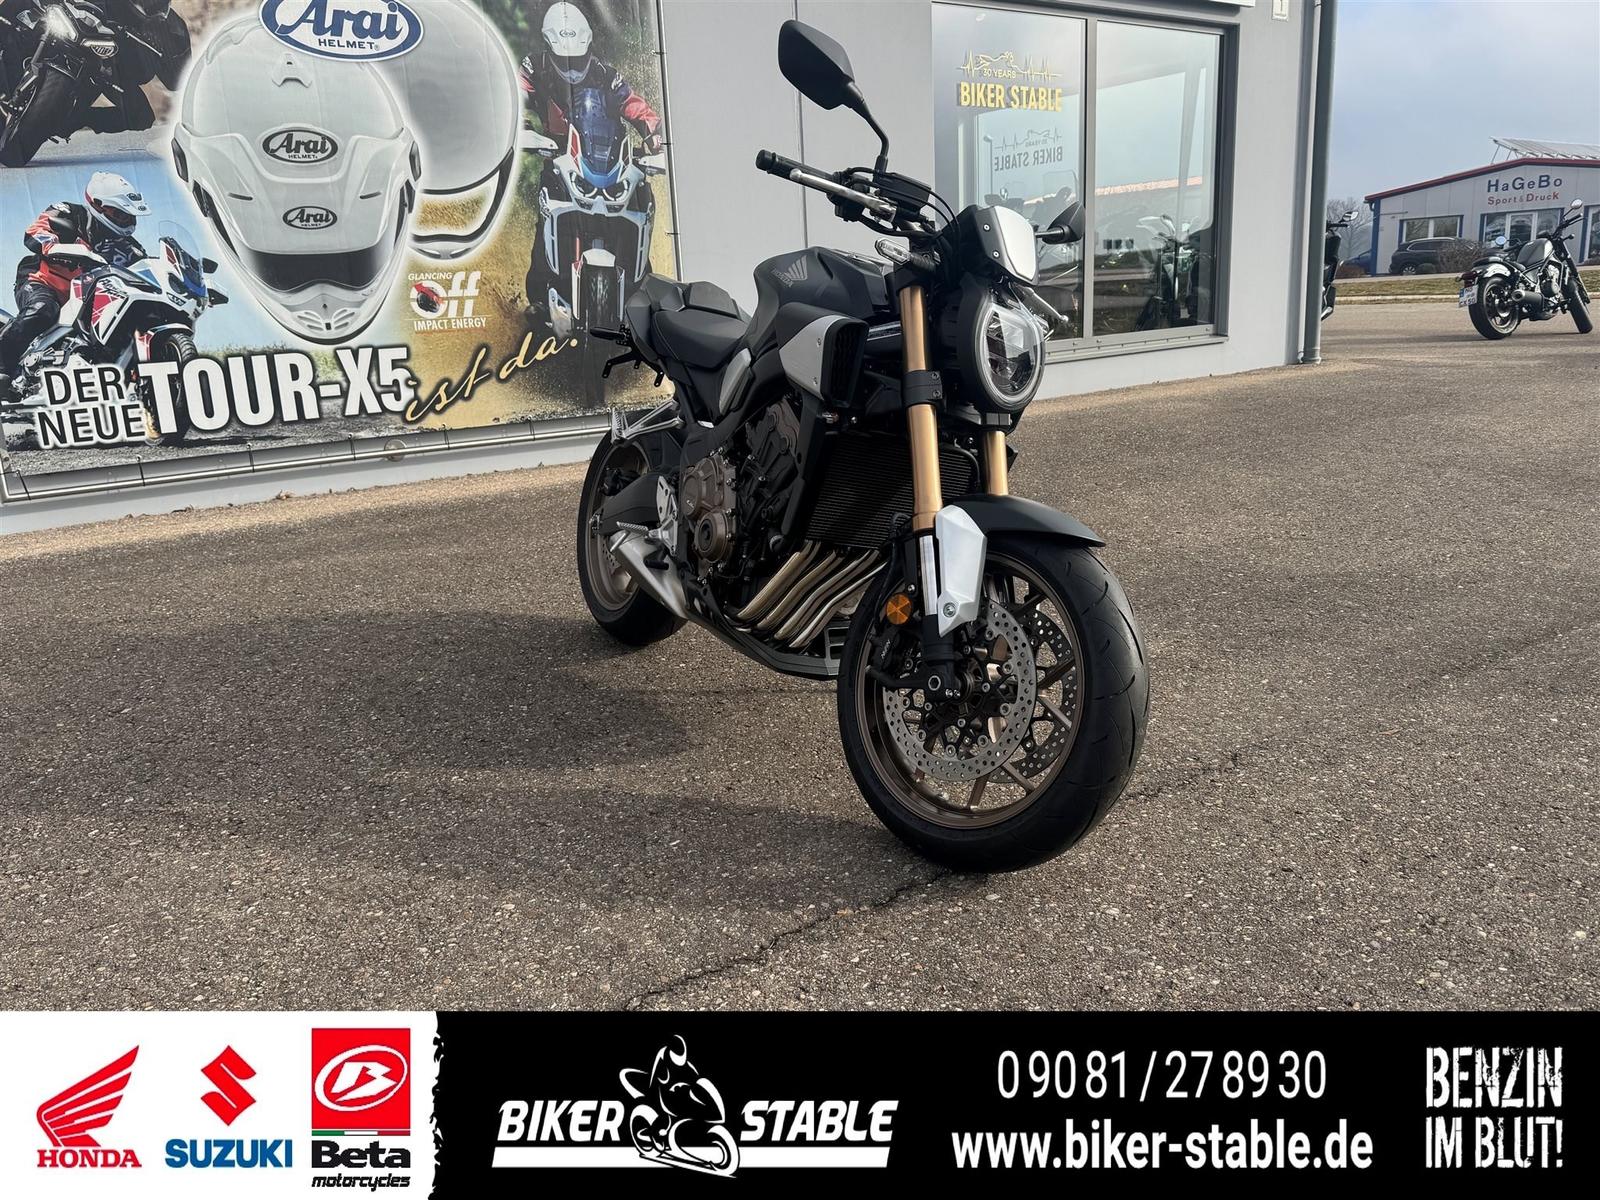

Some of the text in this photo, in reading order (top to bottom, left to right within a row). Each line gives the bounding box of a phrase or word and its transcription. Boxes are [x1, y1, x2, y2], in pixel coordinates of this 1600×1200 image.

[275, 0, 403, 40] Arai
[318, 38, 375, 50] HELMET
[982, 68, 1017, 79] 30 YEARS
[960, 81, 1063, 112] BIKER STABLE
[269, 133, 330, 154] Arai
[1487, 174, 1563, 193] HaGeBo
[1487, 196, 1518, 206] Sport
[286, 208, 332, 223] Arai
[408, 272, 453, 281] GLANCING
[413, 317, 487, 331] IMPACT ENERGY
[44, 366, 124, 406] DER
[138, 346, 415, 434] TOUR-X5
[405, 347, 490, 422] ist
[37, 403, 145, 446] NEUE
